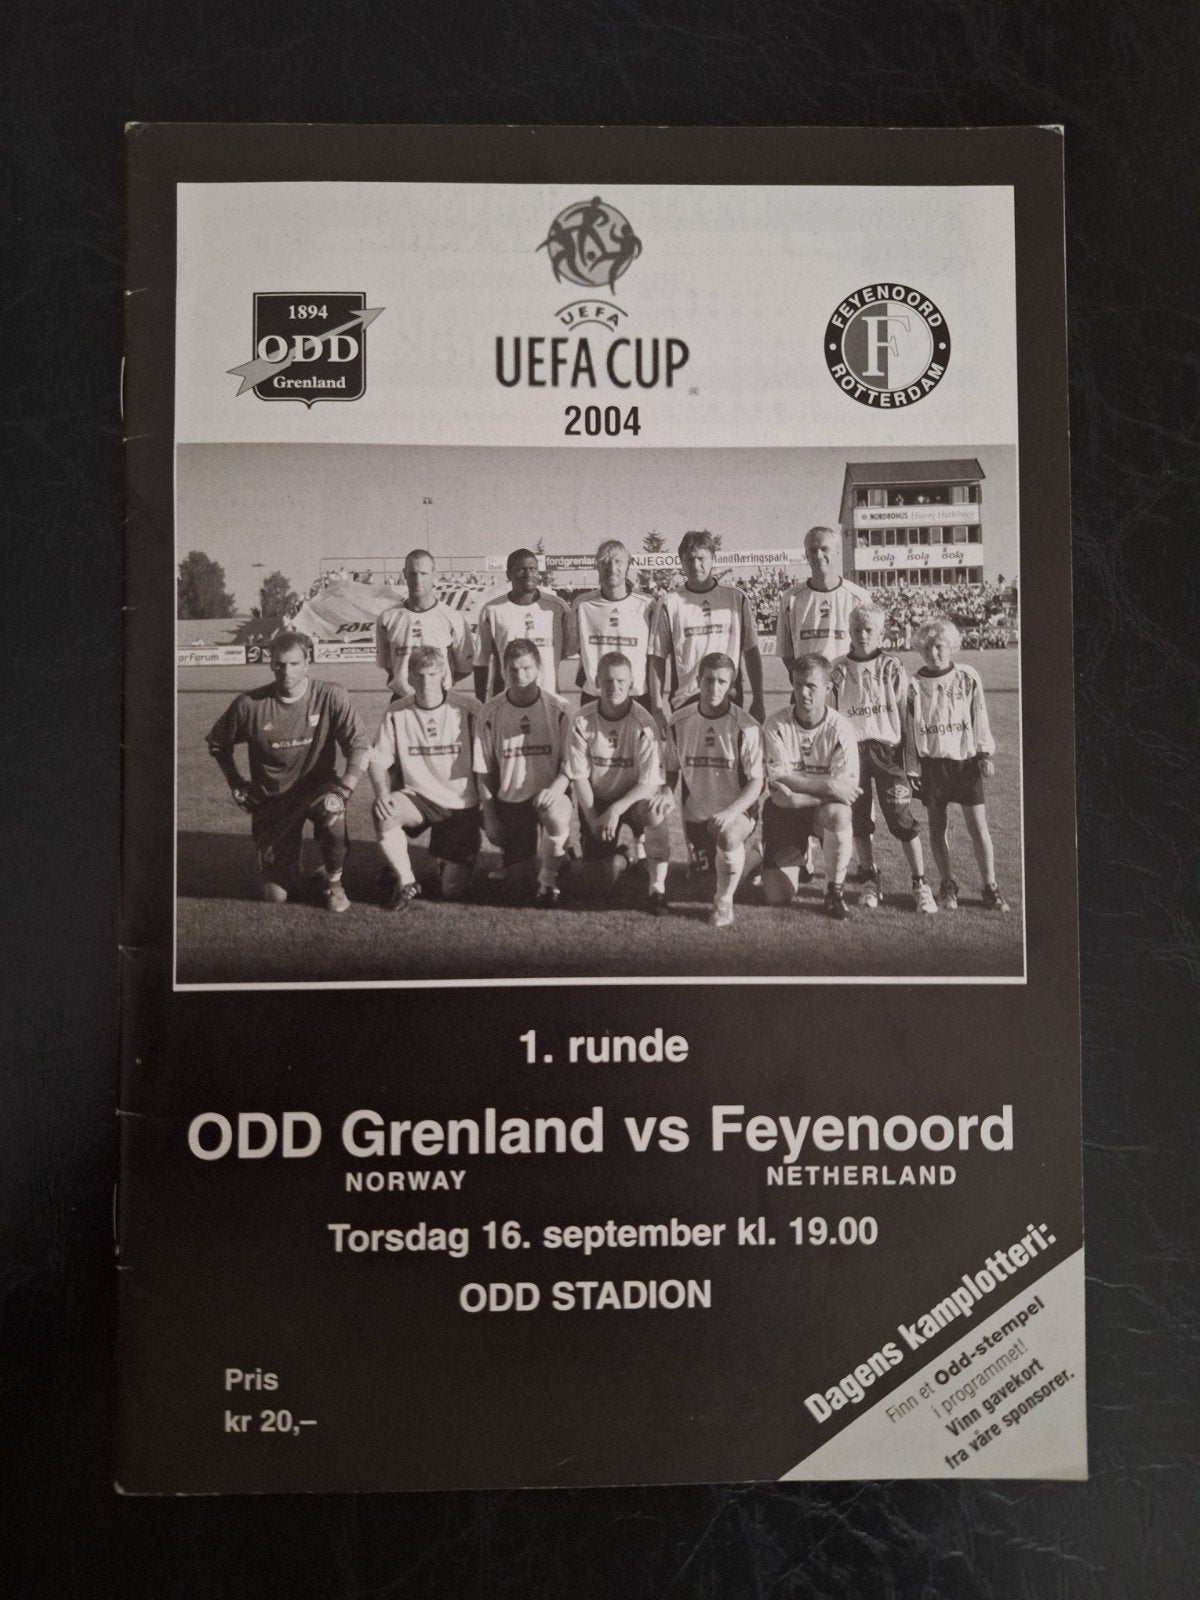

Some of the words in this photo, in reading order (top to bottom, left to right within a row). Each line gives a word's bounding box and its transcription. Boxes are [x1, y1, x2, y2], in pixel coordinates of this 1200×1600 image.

[288, 304, 328, 320] 1894
[560, 306, 619, 326] UEFA
[831, 285, 943, 329] FEYENOORD
[257, 334, 359, 363] ODD
[495, 336, 597, 388] UEFA
[606, 337, 690, 389] CUP
[273, 375, 346, 390] Grenland
[831, 362, 945, 407] ROTTERDAM
[564, 405, 642, 436] 2004
[872, 553, 896, 563] isola
[906, 551, 930, 561] isola
[941, 550, 964, 560] isola
[846, 703, 893, 718] skagerak
[919, 720, 969, 736] skagerak
[519, 1029, 553, 1064] 1.
[568, 1027, 690, 1063] runde
[188, 1111, 323, 1161] ODD
[341, 1106, 604, 1158] Grenland
[624, 1116, 690, 1153] vs
[711, 1104, 1014, 1164] Feyenoord
[345, 1170, 467, 1192] NORWAY
[766, 1165, 957, 1186] NETHERLAND
[327, 1222, 470, 1258] Torsdag
[482, 1220, 532, 1250] 16.
[542, 1217, 727, 1256] september
[737, 1217, 777, 1246] kl.
[789, 1215, 878, 1246] 19.00
[459, 1282, 541, 1313] ODD
[551, 1279, 712, 1312] STADION
[803, 1341, 904, 1424] Dagens
[897, 1222, 1057, 1350] kamplotteri:
[884, 1393, 919, 1423] Finn
[918, 1381, 937, 1399] et
[934, 1295, 1045, 1387] Odd-stempel
[225, 1368, 279, 1391] Pris
[940, 1338, 1029, 1415] programmet!
[945, 1406, 982, 1437] Vinn
[982, 1358, 1045, 1414] gavekort
[224, 1410, 253, 1433] kr
[944, 1448, 971, 1469] fra
[968, 1422, 1002, 1452] våre
[1001, 1370, 1076, 1429] sponsorer.
